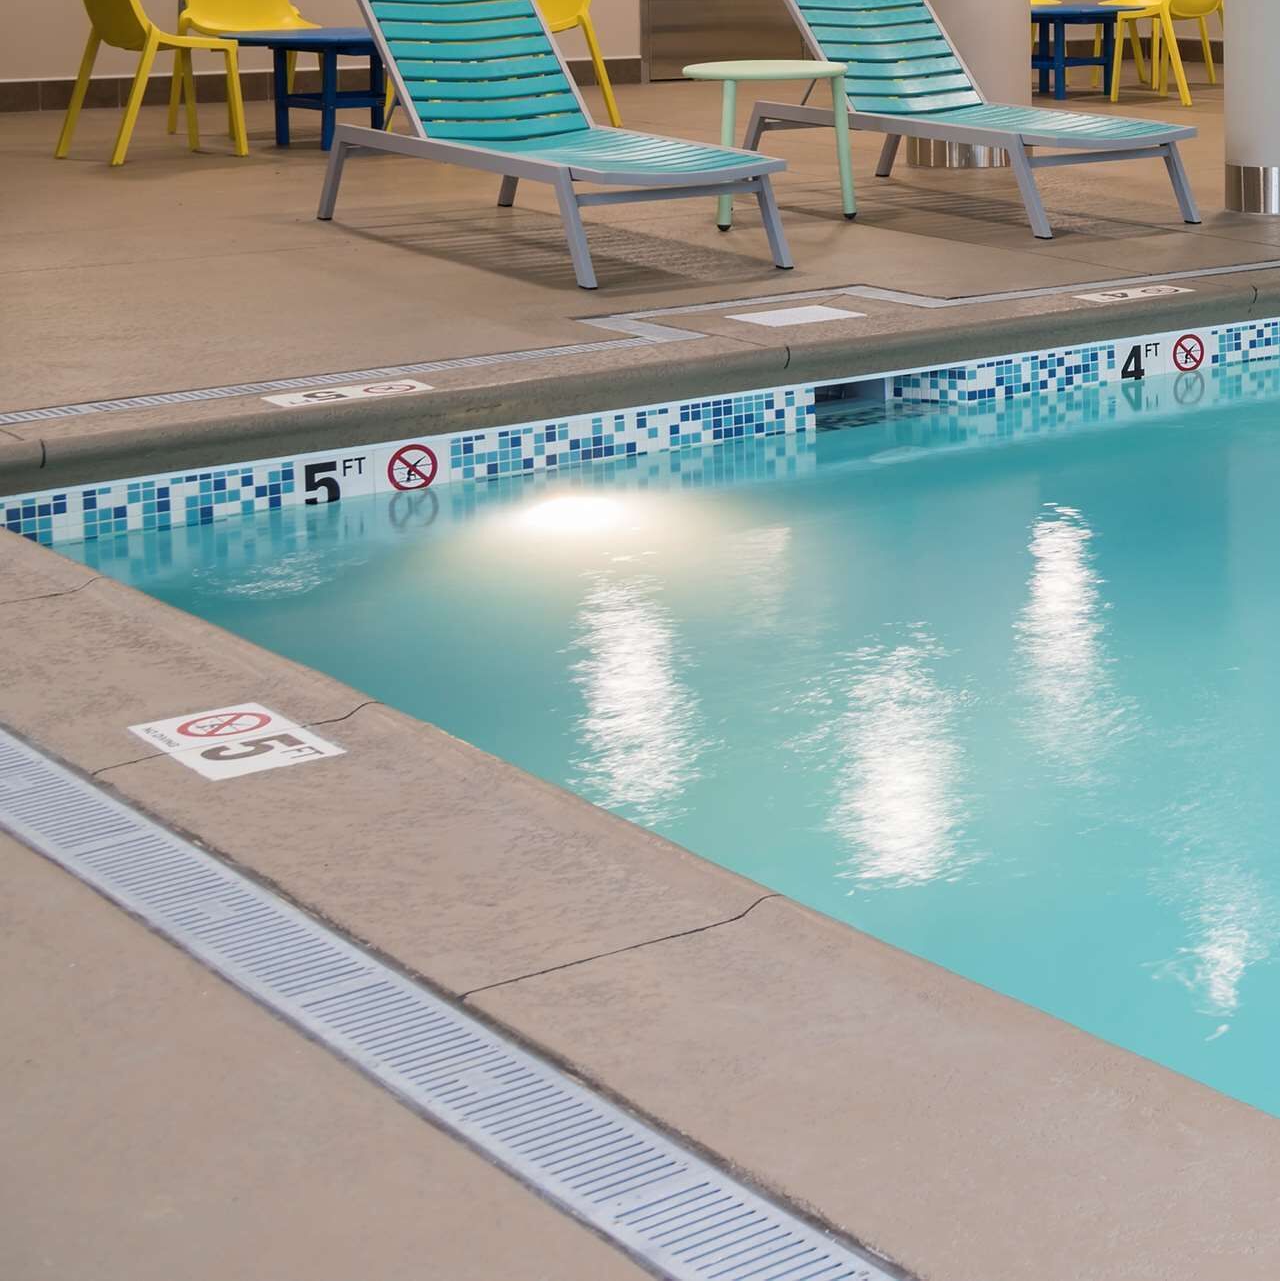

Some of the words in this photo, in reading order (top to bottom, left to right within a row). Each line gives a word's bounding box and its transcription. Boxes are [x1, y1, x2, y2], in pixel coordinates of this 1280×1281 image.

[1121, 345, 1145, 380] 4
[1145, 343, 1160, 357] FT
[304, 461, 341, 505] 5
[342, 457, 366, 477] FT
[200, 733, 304, 761] 5
[279, 745, 325, 759] FT
